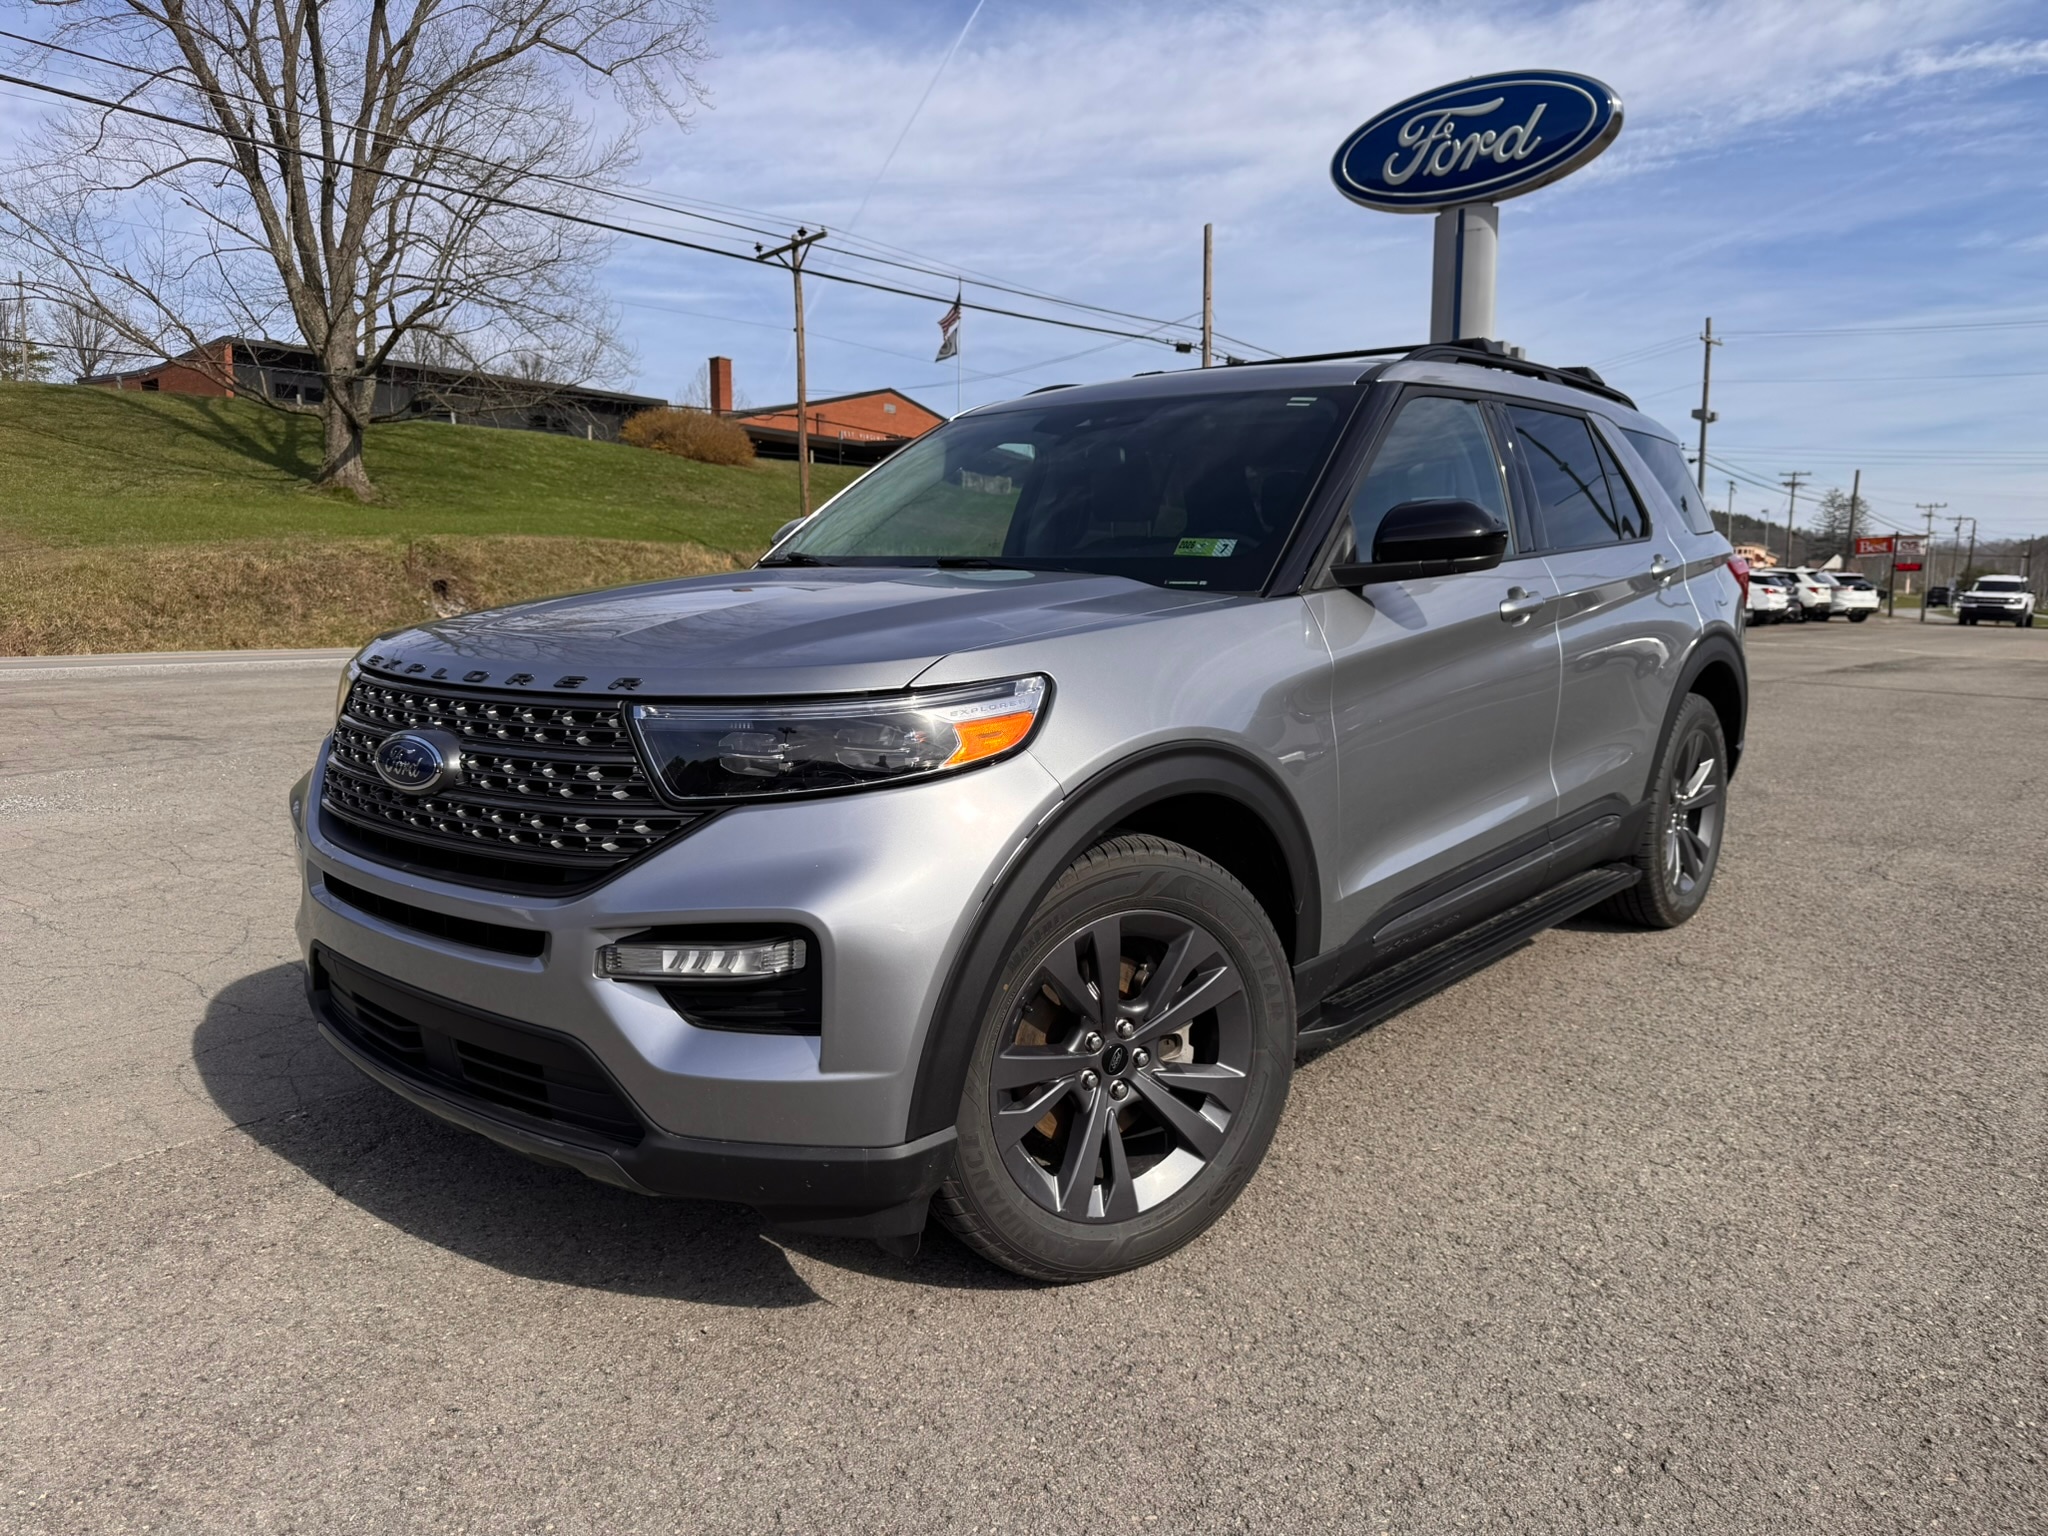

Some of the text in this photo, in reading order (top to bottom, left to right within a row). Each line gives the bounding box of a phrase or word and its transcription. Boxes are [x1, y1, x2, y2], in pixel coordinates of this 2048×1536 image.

[1382, 97, 1548, 186] Ford
[1219, 543, 1229, 553] 7
[1860, 540, 1888, 553] Best
[366, 654, 645, 691] EXPLORER
[949, 699, 1026, 717] EXPLORER
[385, 745, 423, 778] Ford
